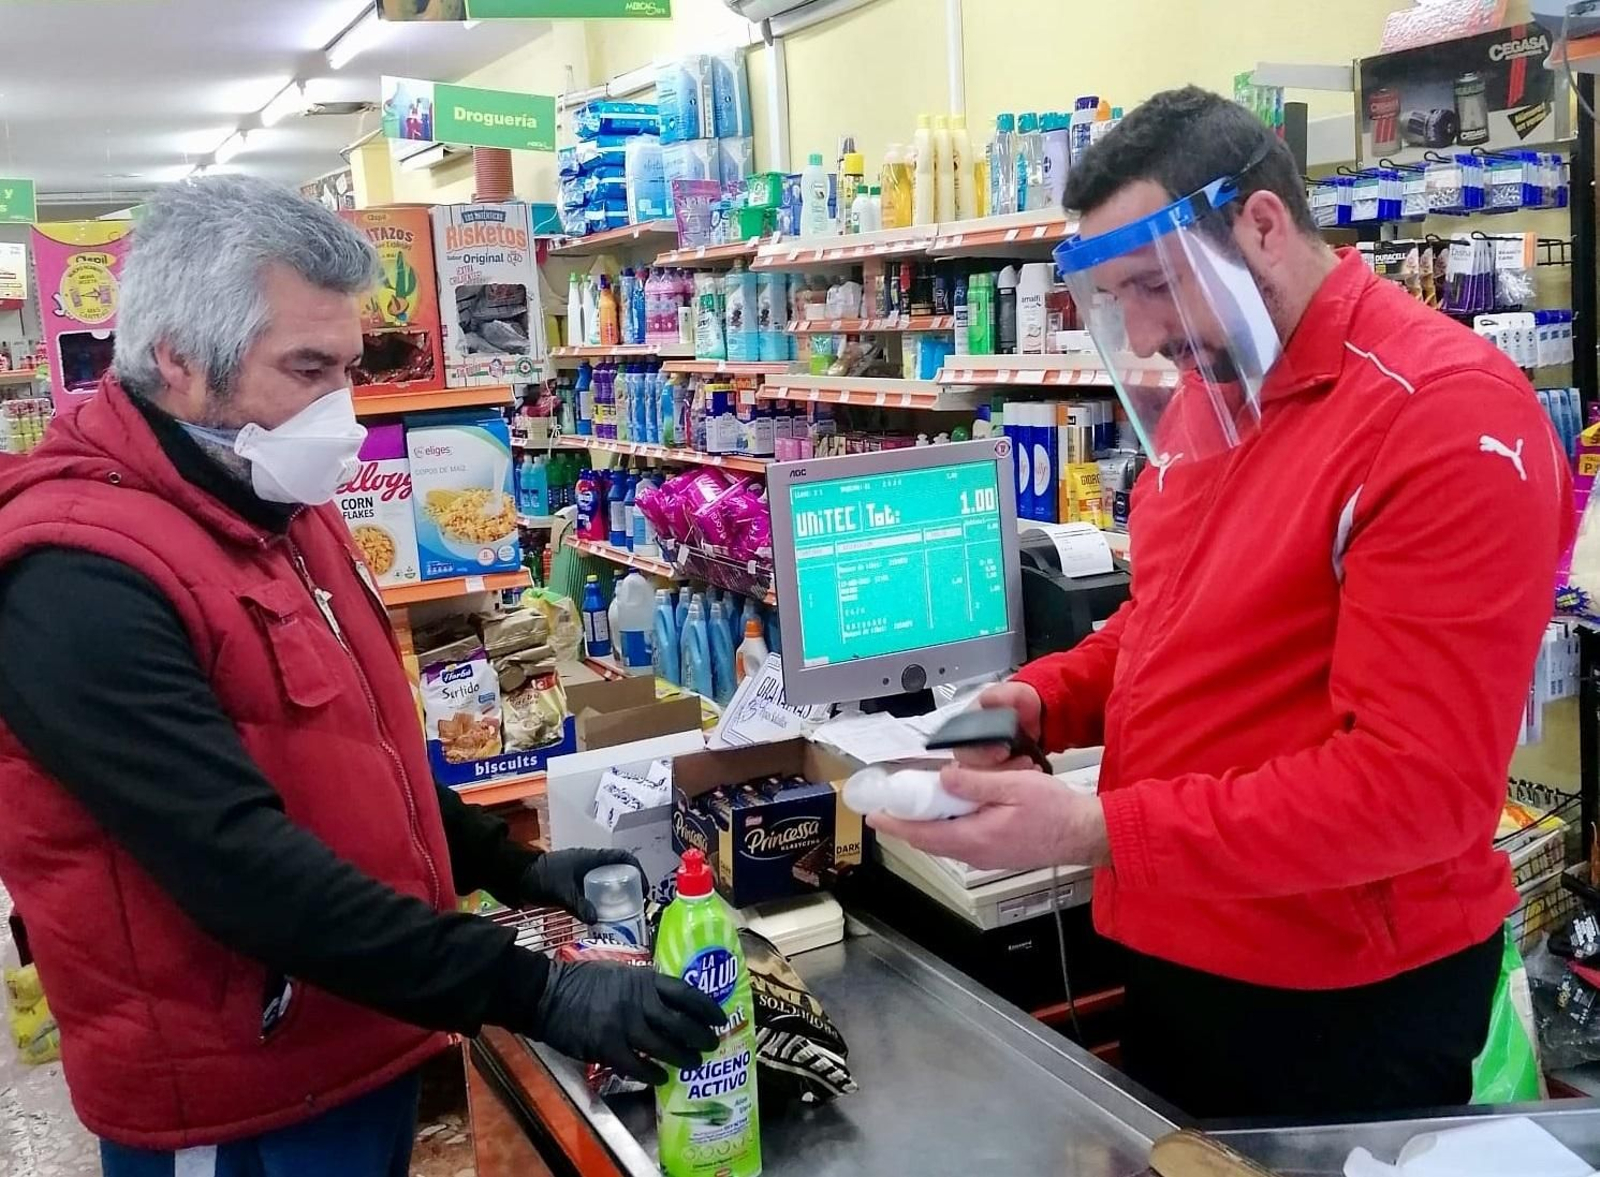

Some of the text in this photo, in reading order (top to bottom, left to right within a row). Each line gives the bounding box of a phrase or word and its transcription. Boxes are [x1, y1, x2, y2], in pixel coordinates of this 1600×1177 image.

[1489, 34, 1549, 61] CEGASA
[454, 106, 537, 129] Droguería
[5, 188, 13, 199] y
[365, 226, 414, 243] ITAZOS
[463, 252, 504, 266] Original
[341, 497, 374, 511] CORN
[960, 487, 996, 515] 1.00
[342, 509, 375, 520] FLAKES
[442, 682, 480, 700] Surtido
[475, 755, 538, 776] biscuits
[744, 820, 820, 854] Princessa
[836, 842, 861, 854] DARK
[702, 954, 715, 970] LA
[684, 955, 738, 995] SALUD
[680, 1050, 750, 1082] OXÍGENO
[687, 1070, 747, 1099] ACTIVO
